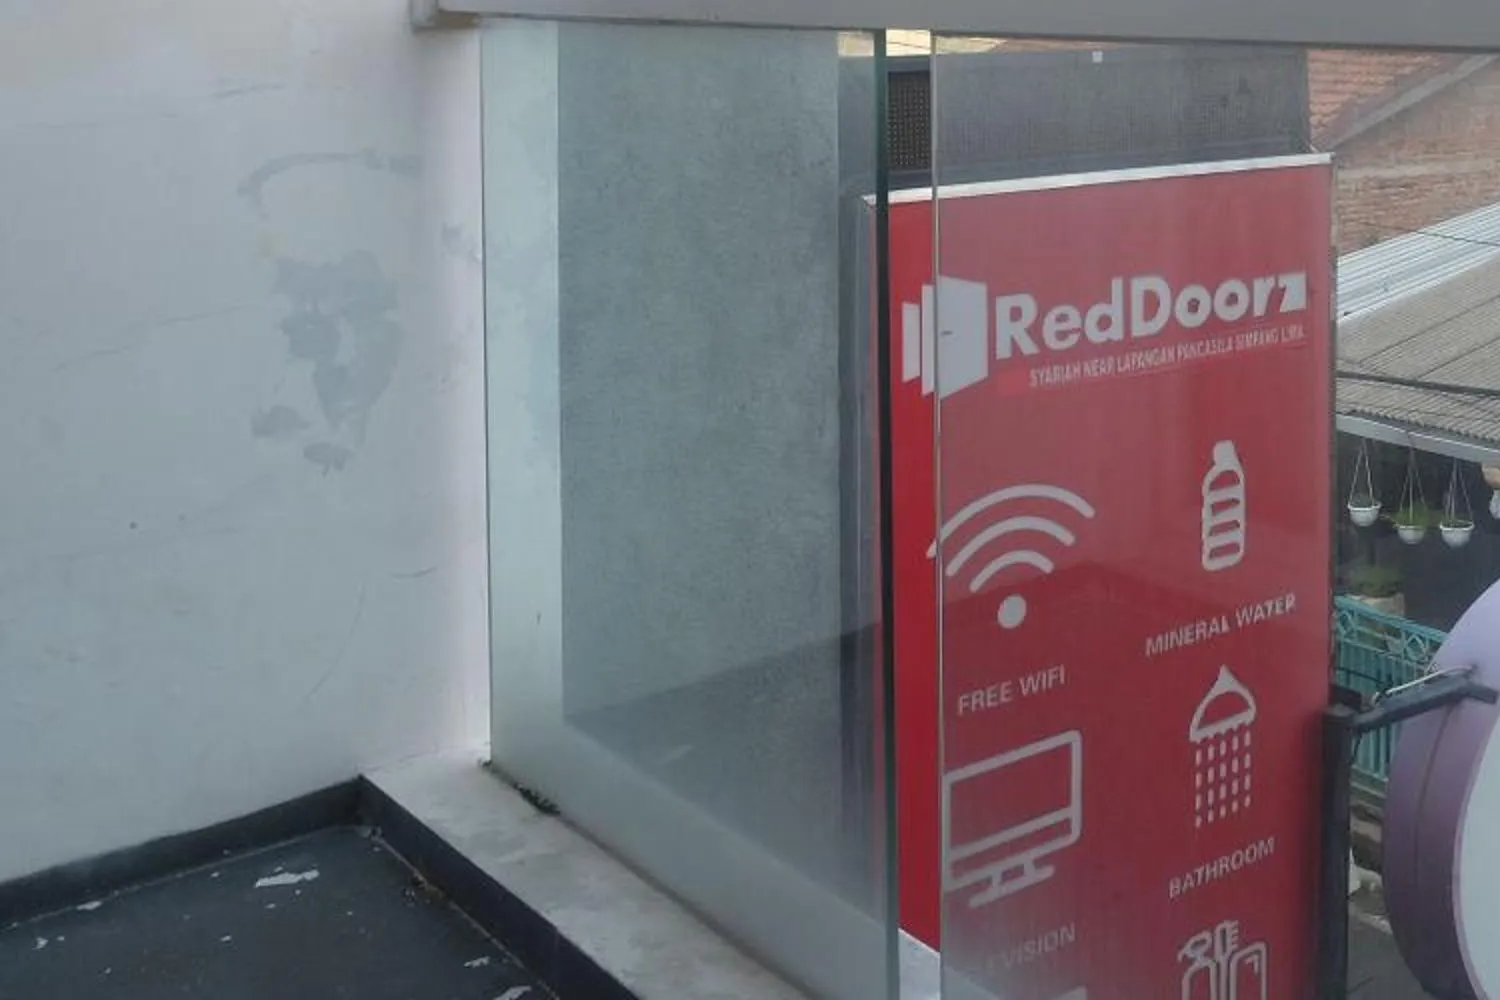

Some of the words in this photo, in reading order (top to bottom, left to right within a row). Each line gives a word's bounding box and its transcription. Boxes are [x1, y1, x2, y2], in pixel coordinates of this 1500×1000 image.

[995, 271, 1307, 361] RedDoorz
[1082, 355, 1115, 379] NEAR
[1145, 616, 1230, 658] MINERAL
[1235, 594, 1297, 630] WATER
[958, 680, 1013, 716] FREE
[1019, 664, 1065, 697] WIFI
[1168, 837, 1275, 899] BATHROOM
